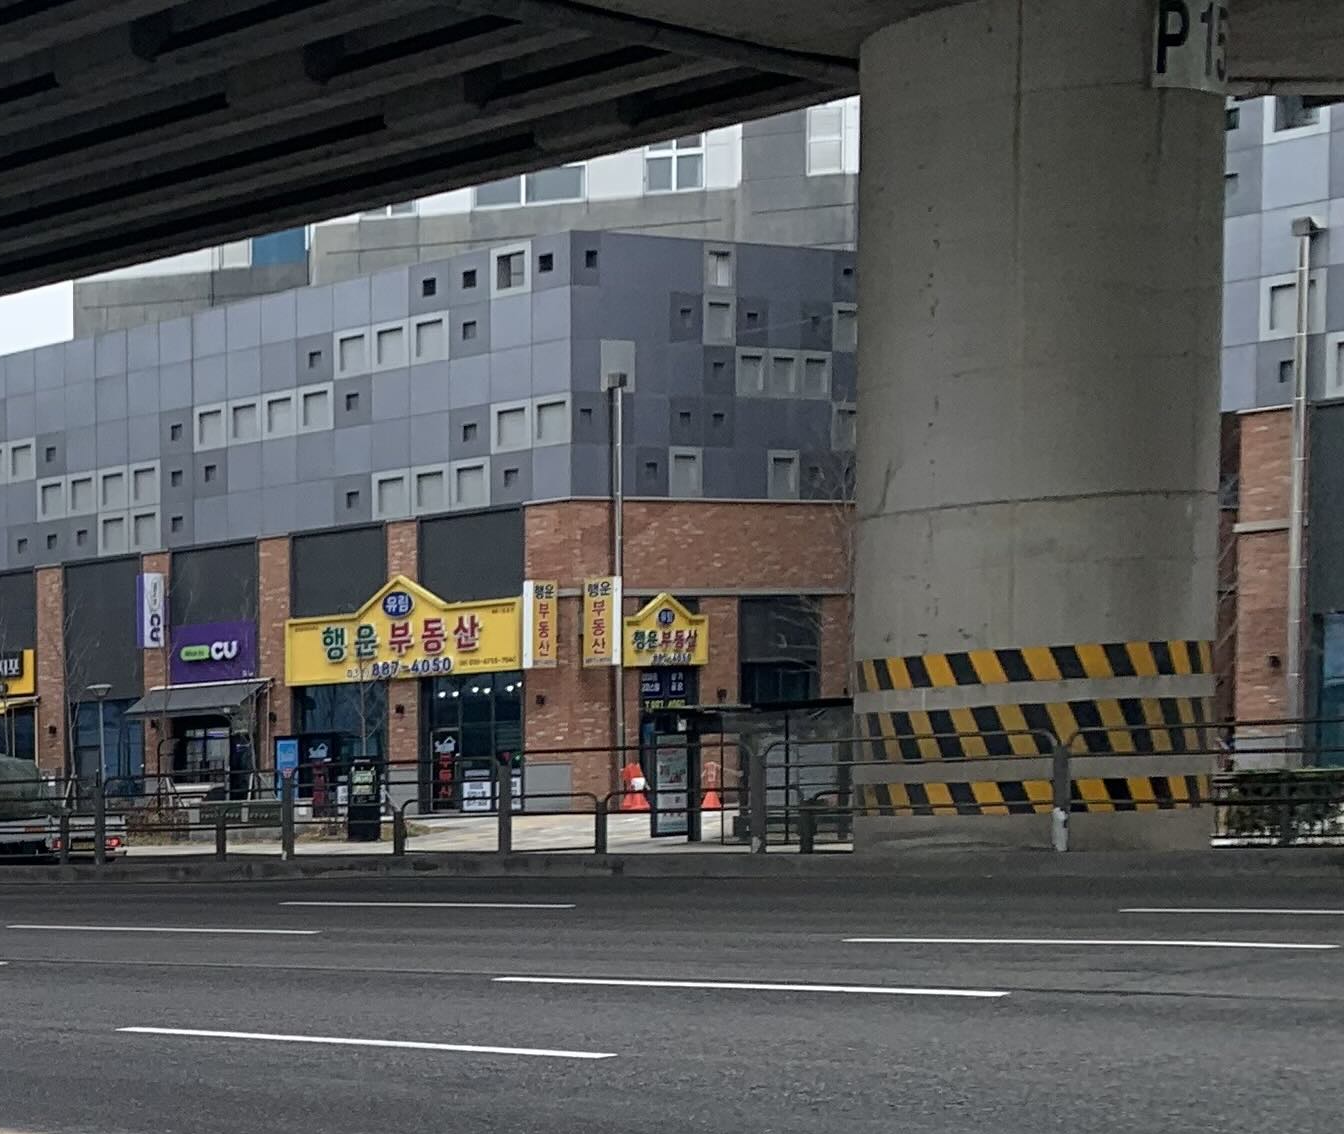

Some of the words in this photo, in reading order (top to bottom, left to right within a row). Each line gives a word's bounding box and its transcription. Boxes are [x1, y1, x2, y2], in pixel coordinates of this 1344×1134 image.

[385, 594, 409, 613] 유림
[538, 603, 550, 657] 부동산
[592, 599, 606, 655] 부동산
[211, 640, 238, 661] CU
